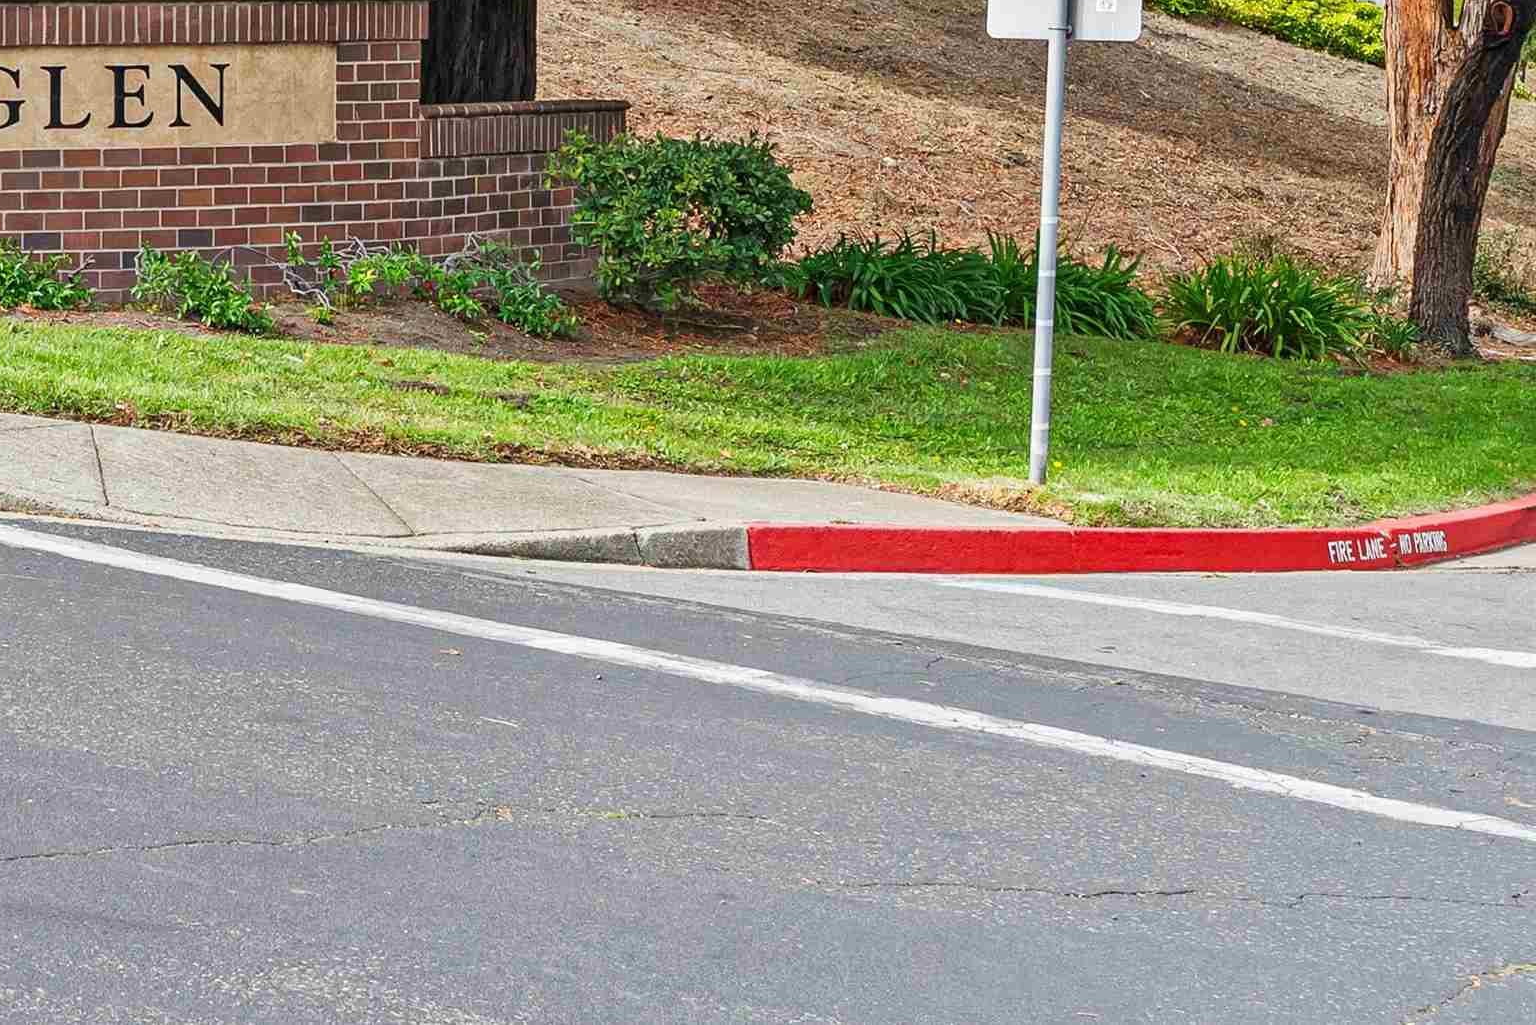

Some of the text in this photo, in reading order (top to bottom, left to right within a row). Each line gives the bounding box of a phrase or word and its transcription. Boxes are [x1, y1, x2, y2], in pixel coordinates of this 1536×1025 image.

[1328, 540, 1355, 563] FIRE
[1357, 537, 1387, 560] LANE
[1398, 533, 1412, 554] NO
[1414, 530, 1448, 553] PARKING
